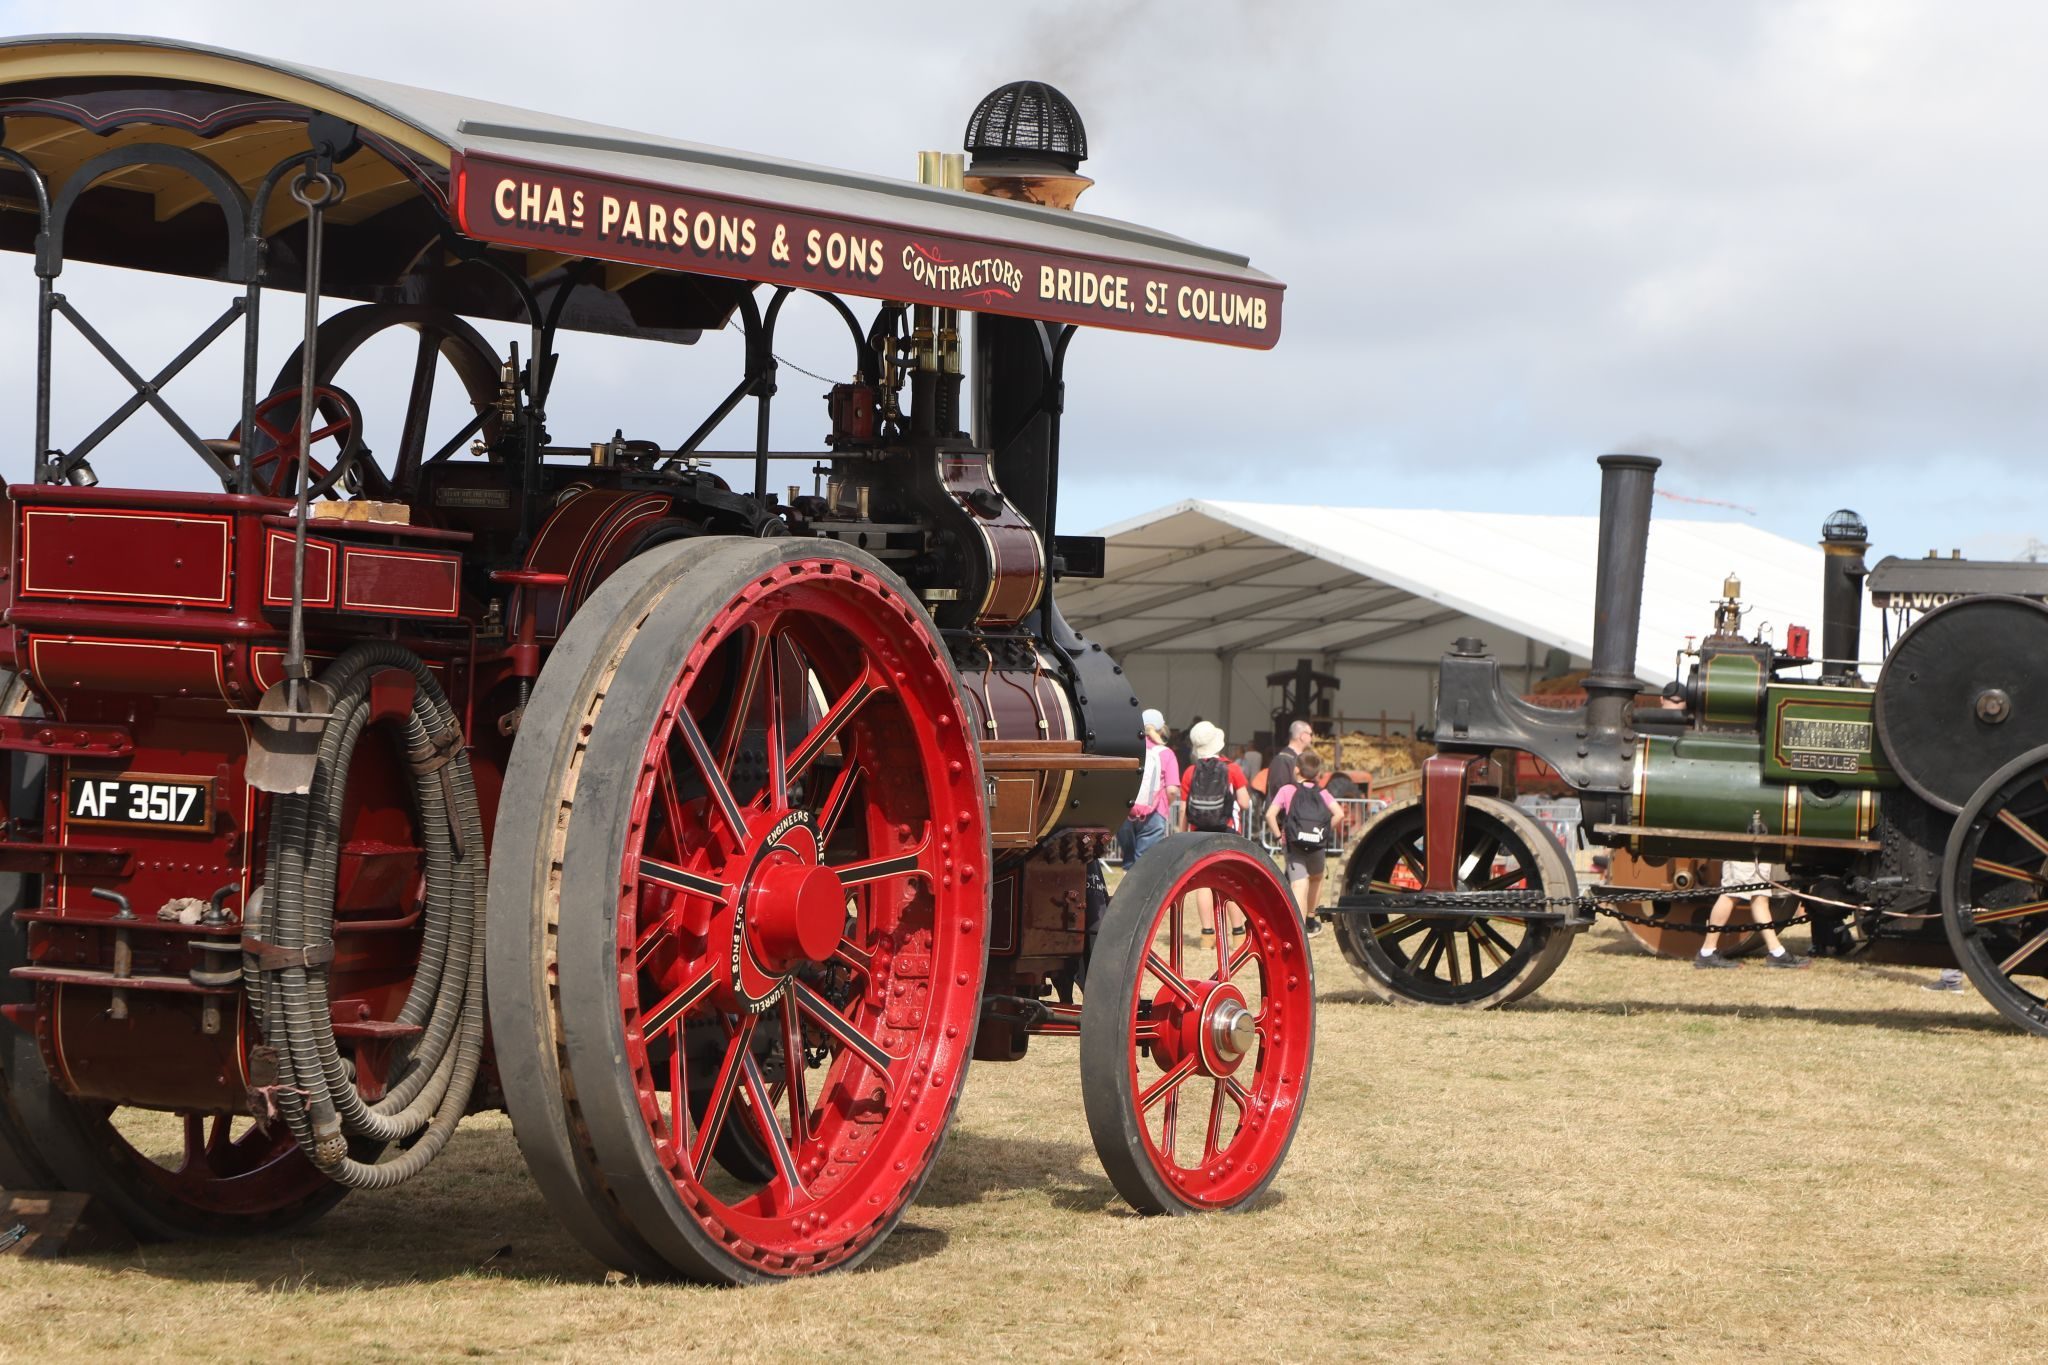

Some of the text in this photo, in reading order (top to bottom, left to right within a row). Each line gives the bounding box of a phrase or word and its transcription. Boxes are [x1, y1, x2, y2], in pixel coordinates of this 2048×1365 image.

[601, 196, 757, 257] PARSONS
[770, 224, 791, 262] &
[806, 230, 885, 276] SONS
[902, 245, 1024, 293] CONTRACTORS
[1040, 265, 1136, 314] BRIDGE,
[1177, 286, 1268, 330] COLUMB
[1792, 753, 1858, 771] HERCULES
[76, 780, 197, 822] AF 3517
[766, 811, 809, 846] ENGINEERS
[817, 831, 825, 866] THE
[735, 904, 745, 929] LTD.
[732, 934, 741, 973] SONS
[734, 979, 742, 992] &
[750, 985, 786, 1014] BURRELL
